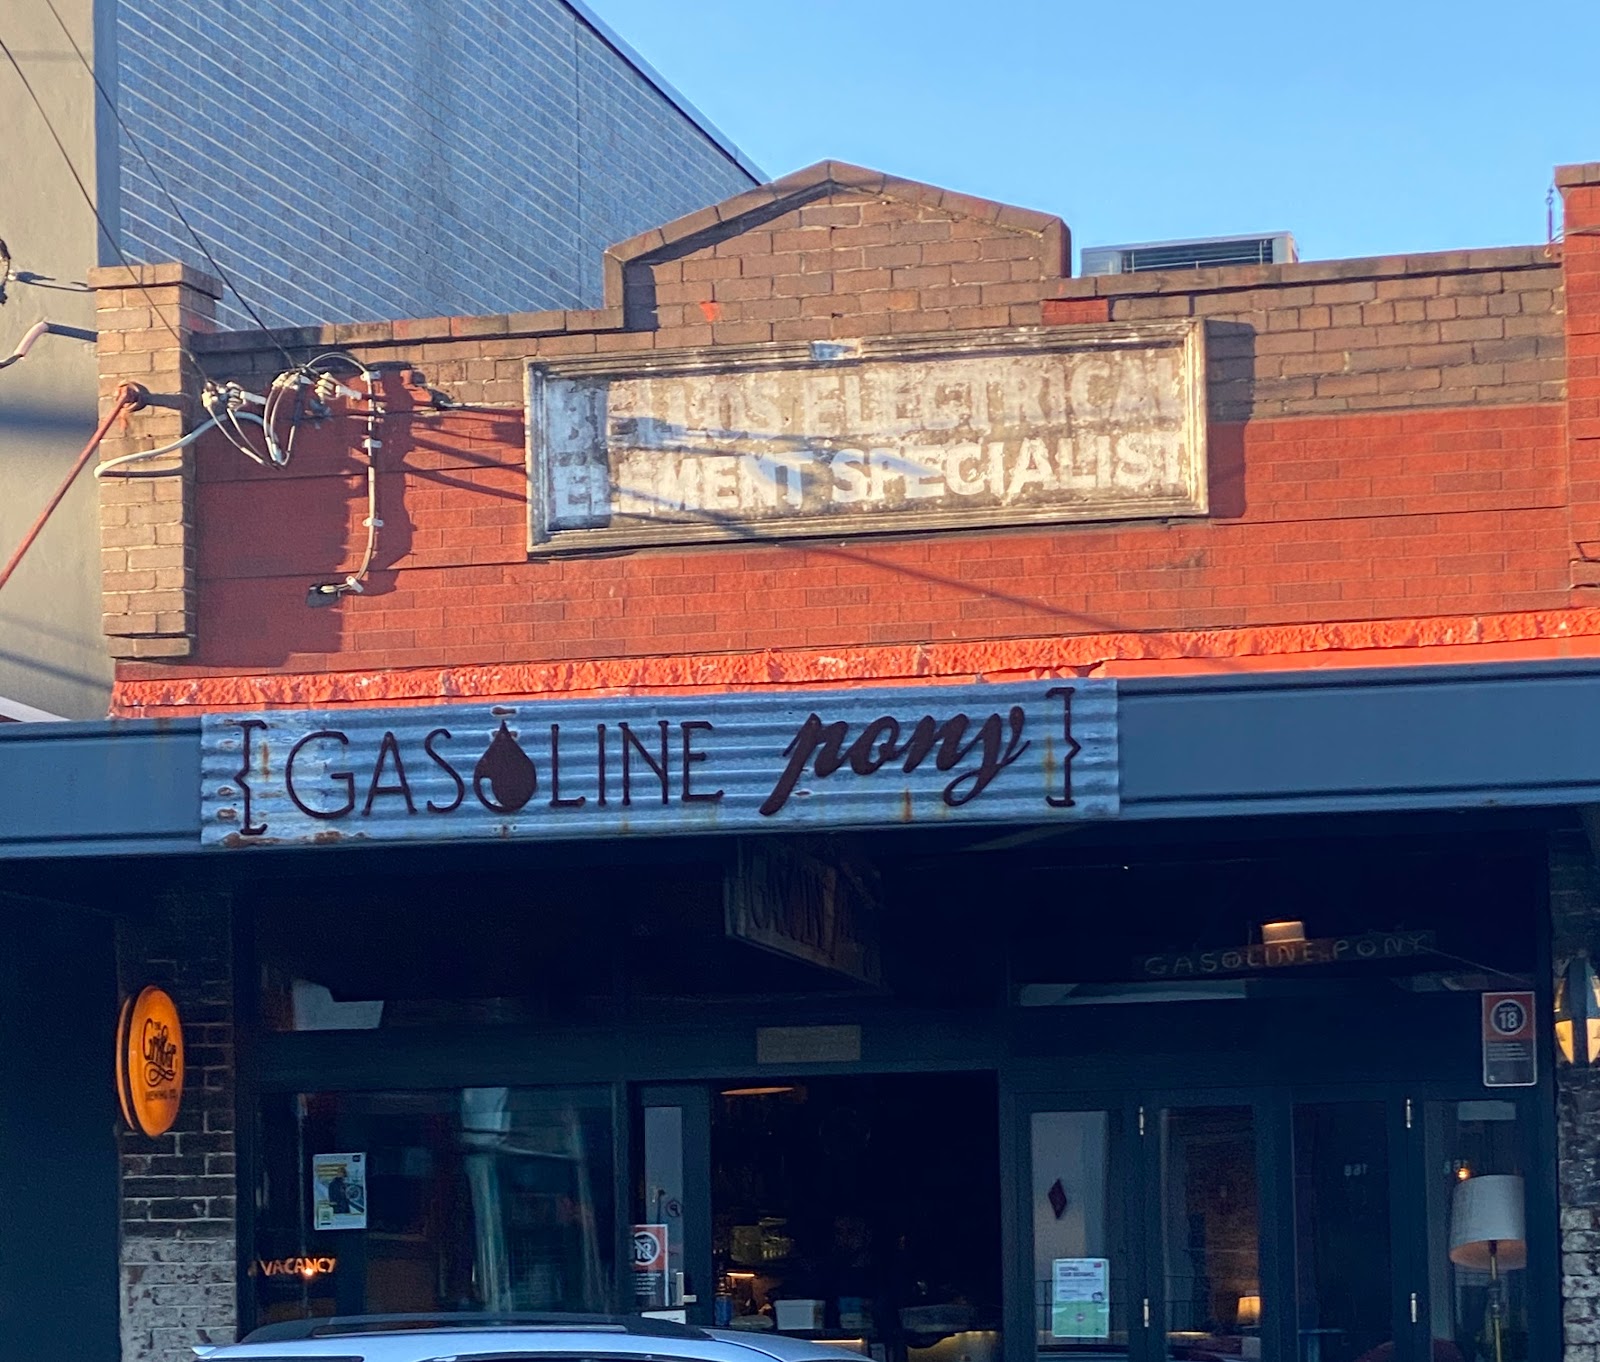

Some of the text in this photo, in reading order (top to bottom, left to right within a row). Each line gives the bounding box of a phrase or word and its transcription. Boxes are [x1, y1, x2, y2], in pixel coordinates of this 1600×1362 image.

[804, 353, 1183, 437] ELECTRICAL
[554, 430, 1188, 516] ELEMENT SPECIALIST
[285, 704, 1031, 818] GASOLINE pony
[1144, 933, 1428, 975] GASOLINE PONY
[1498, 1011, 1518, 1029] 18
[258, 1257, 337, 1277] VACANCY
